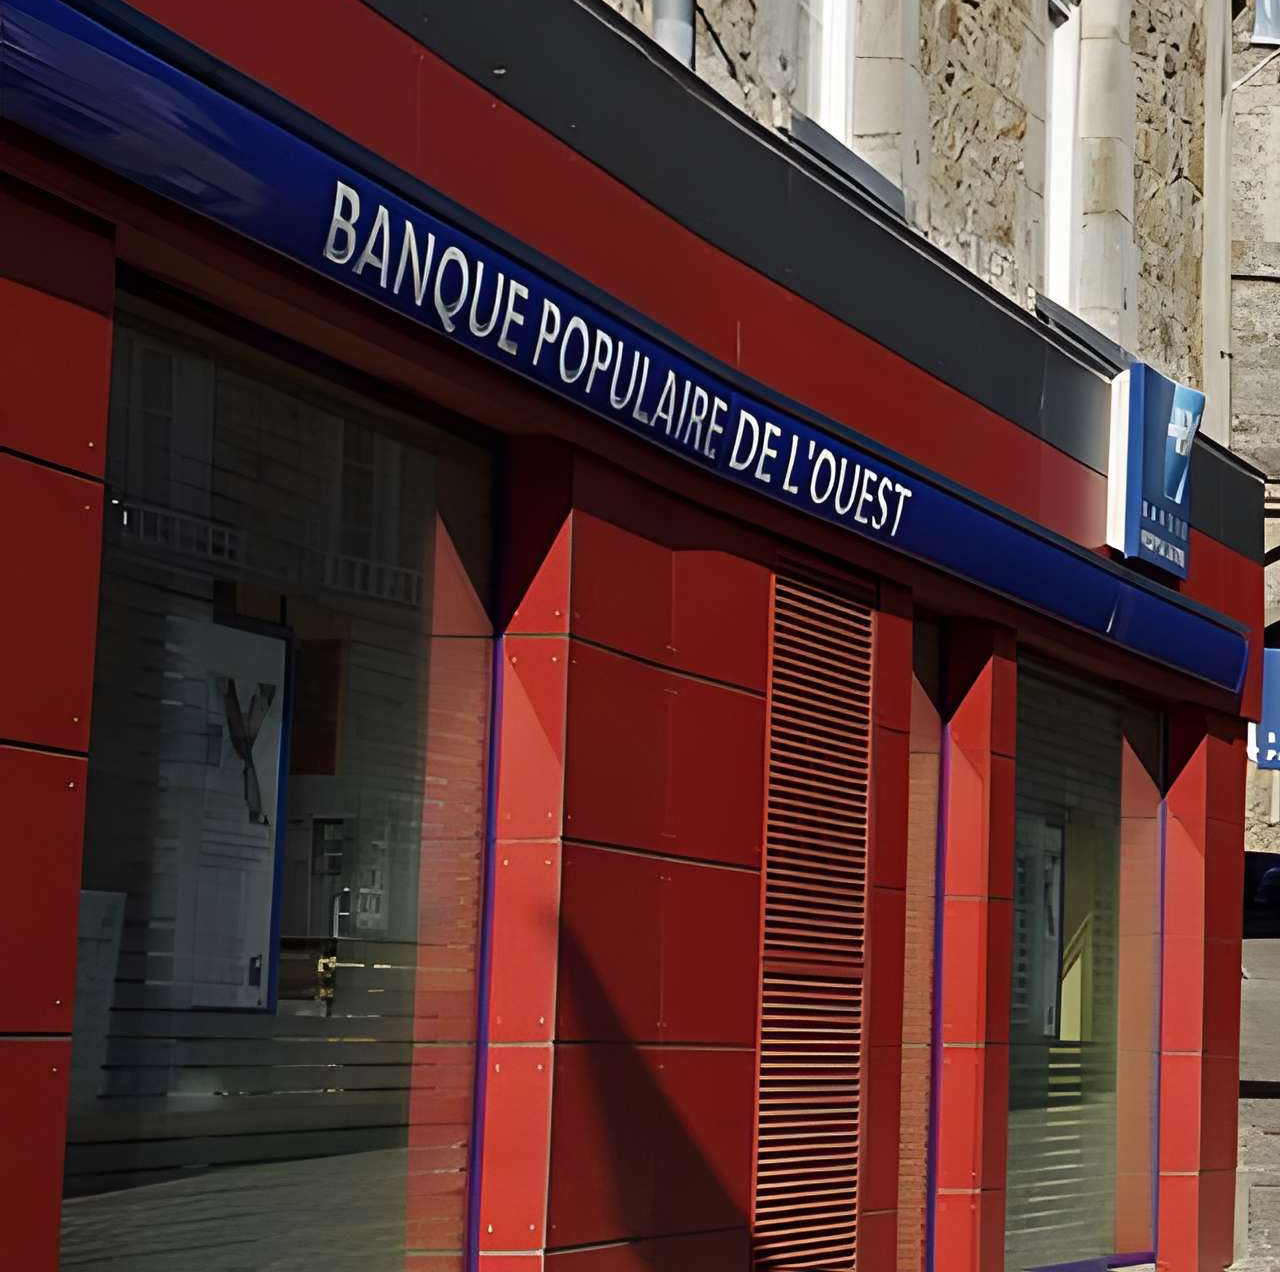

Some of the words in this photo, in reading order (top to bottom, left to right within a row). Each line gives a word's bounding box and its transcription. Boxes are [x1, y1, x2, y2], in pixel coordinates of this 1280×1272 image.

[322, 180, 529, 356] BANQUE
[532, 297, 729, 461] POPULAIRE
[729, 409, 782, 484] DE
[782, 434, 912, 537] L'OUEST
